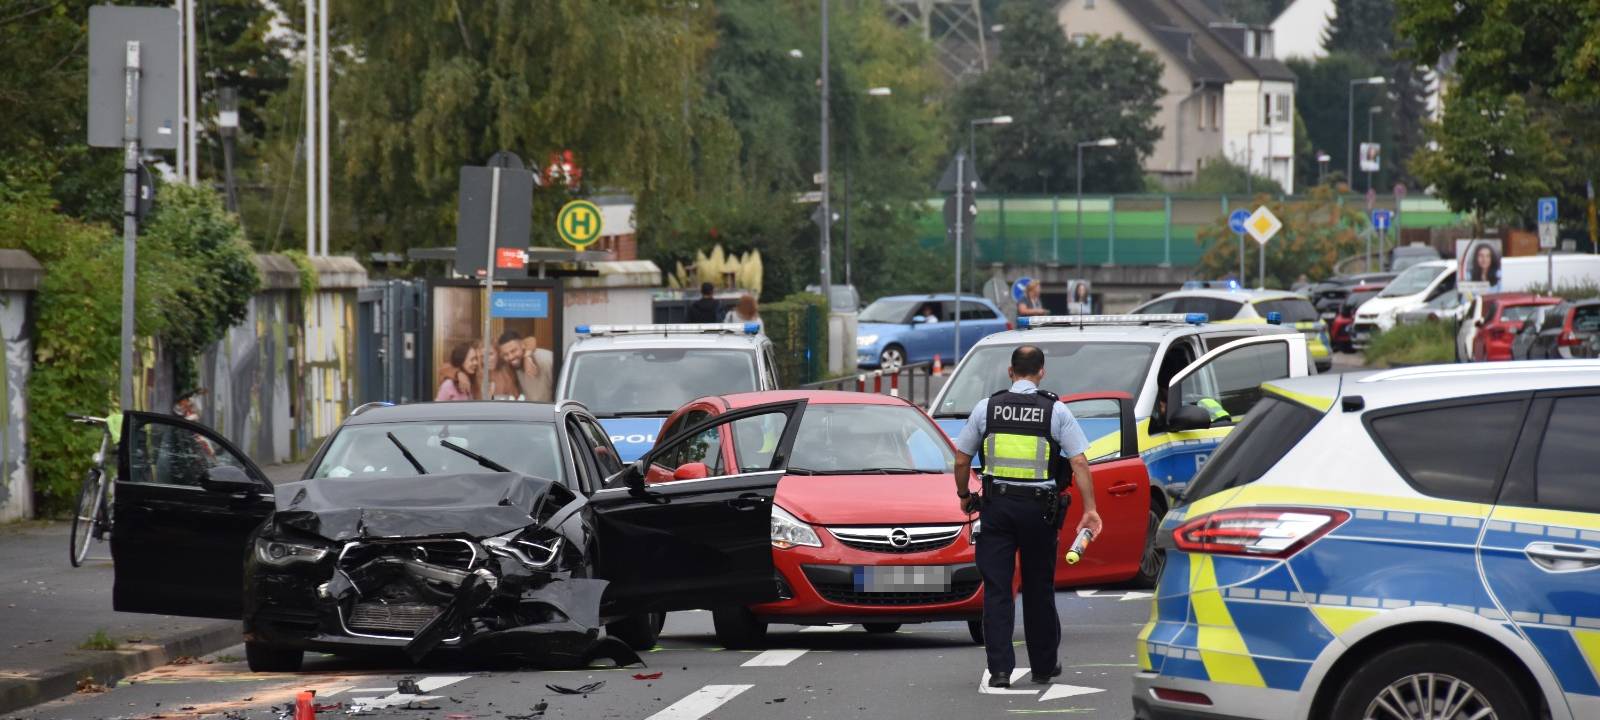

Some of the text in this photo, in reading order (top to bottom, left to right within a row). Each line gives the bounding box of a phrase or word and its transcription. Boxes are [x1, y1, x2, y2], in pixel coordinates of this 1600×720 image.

[571, 212, 590, 234] H
[1543, 202, 1553, 223] P
[994, 405, 1044, 422] POLIZEI
